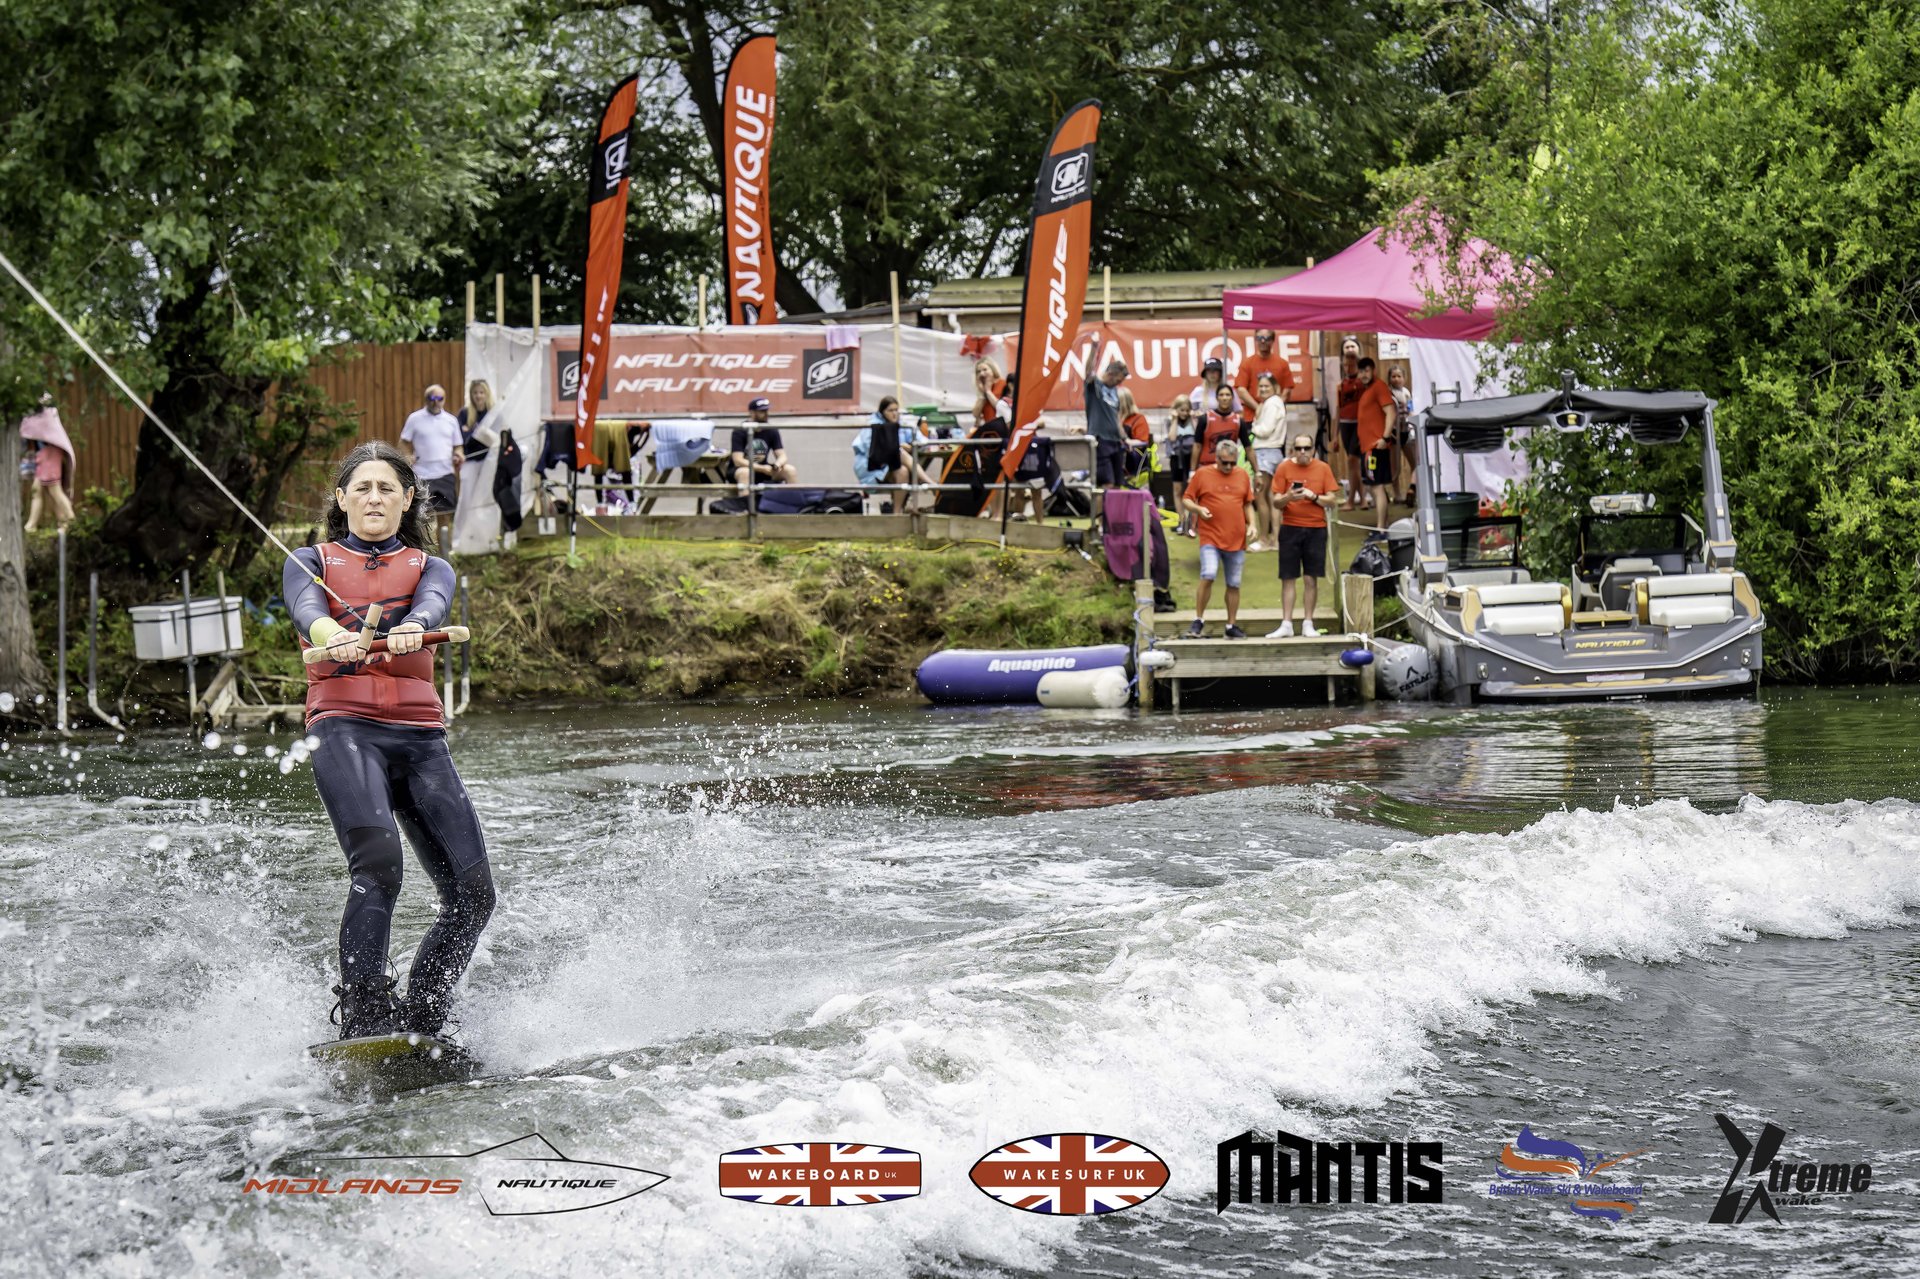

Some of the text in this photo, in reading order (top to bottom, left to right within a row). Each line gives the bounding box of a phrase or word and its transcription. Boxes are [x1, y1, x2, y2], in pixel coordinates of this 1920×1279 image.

[734, 85, 766, 302] NAUTIQUE
[613, 353, 794, 370] NAUTIQUE
[614, 377, 794, 394] NAUTIQUE
[1575, 638, 1647, 649] NAUTIQUE
[987, 656, 1076, 673] Aquaglide
